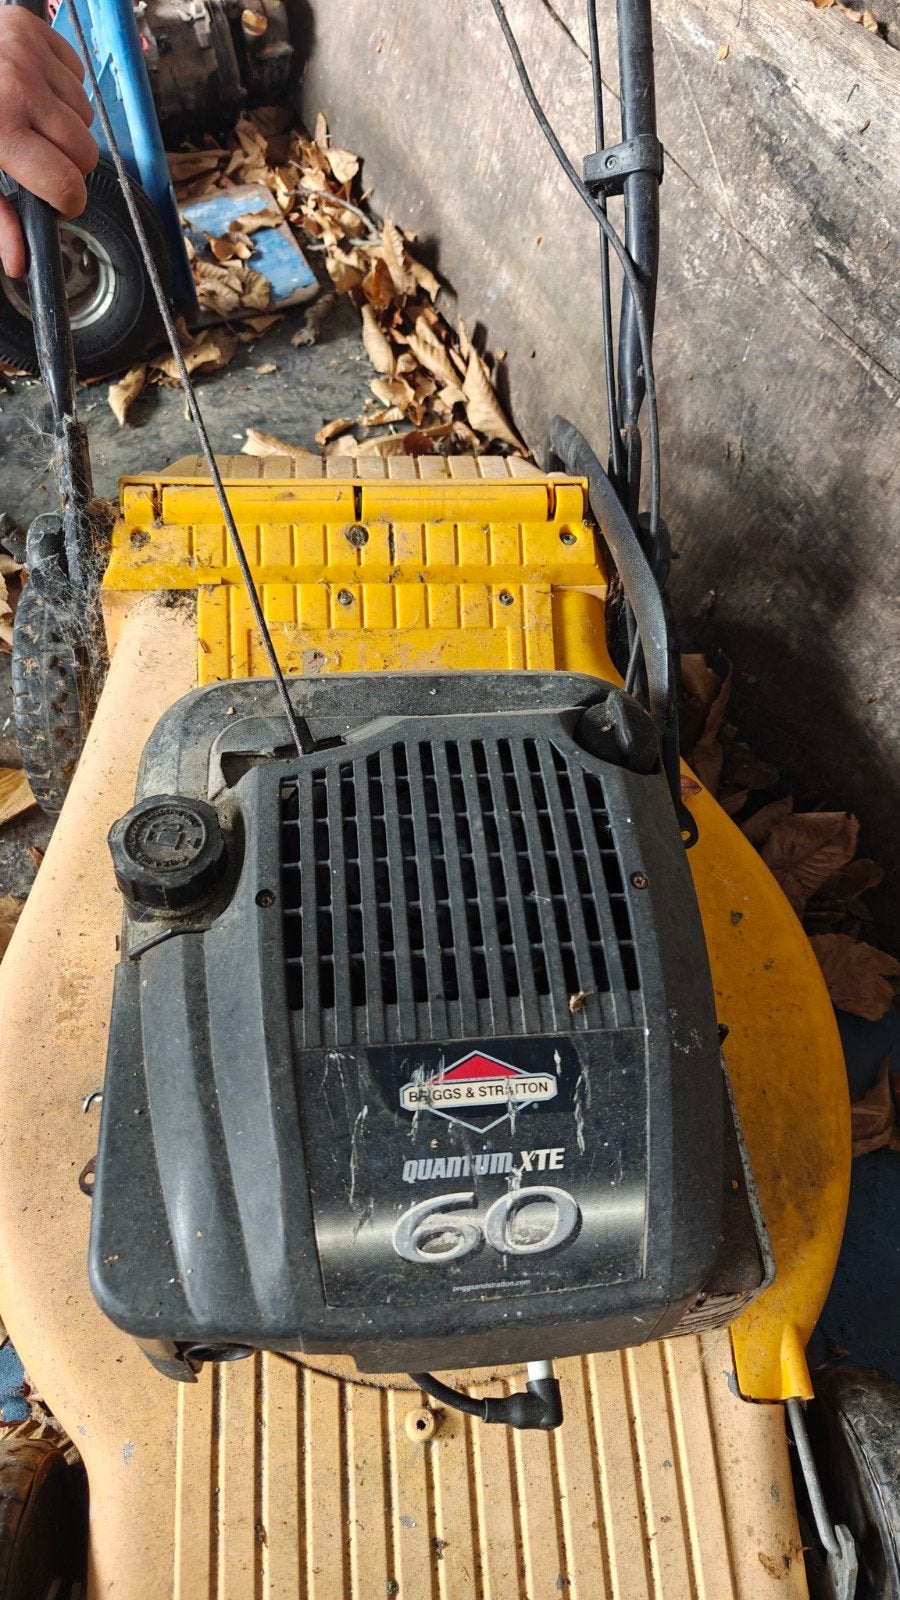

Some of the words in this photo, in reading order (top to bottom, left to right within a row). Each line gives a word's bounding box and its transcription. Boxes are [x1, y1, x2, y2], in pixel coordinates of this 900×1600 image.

[466, 1087, 475, 1098] &
[402, 1151, 514, 1184] QUANTUM
[520, 1147, 566, 1172] XTE
[392, 1185, 580, 1263] 60
